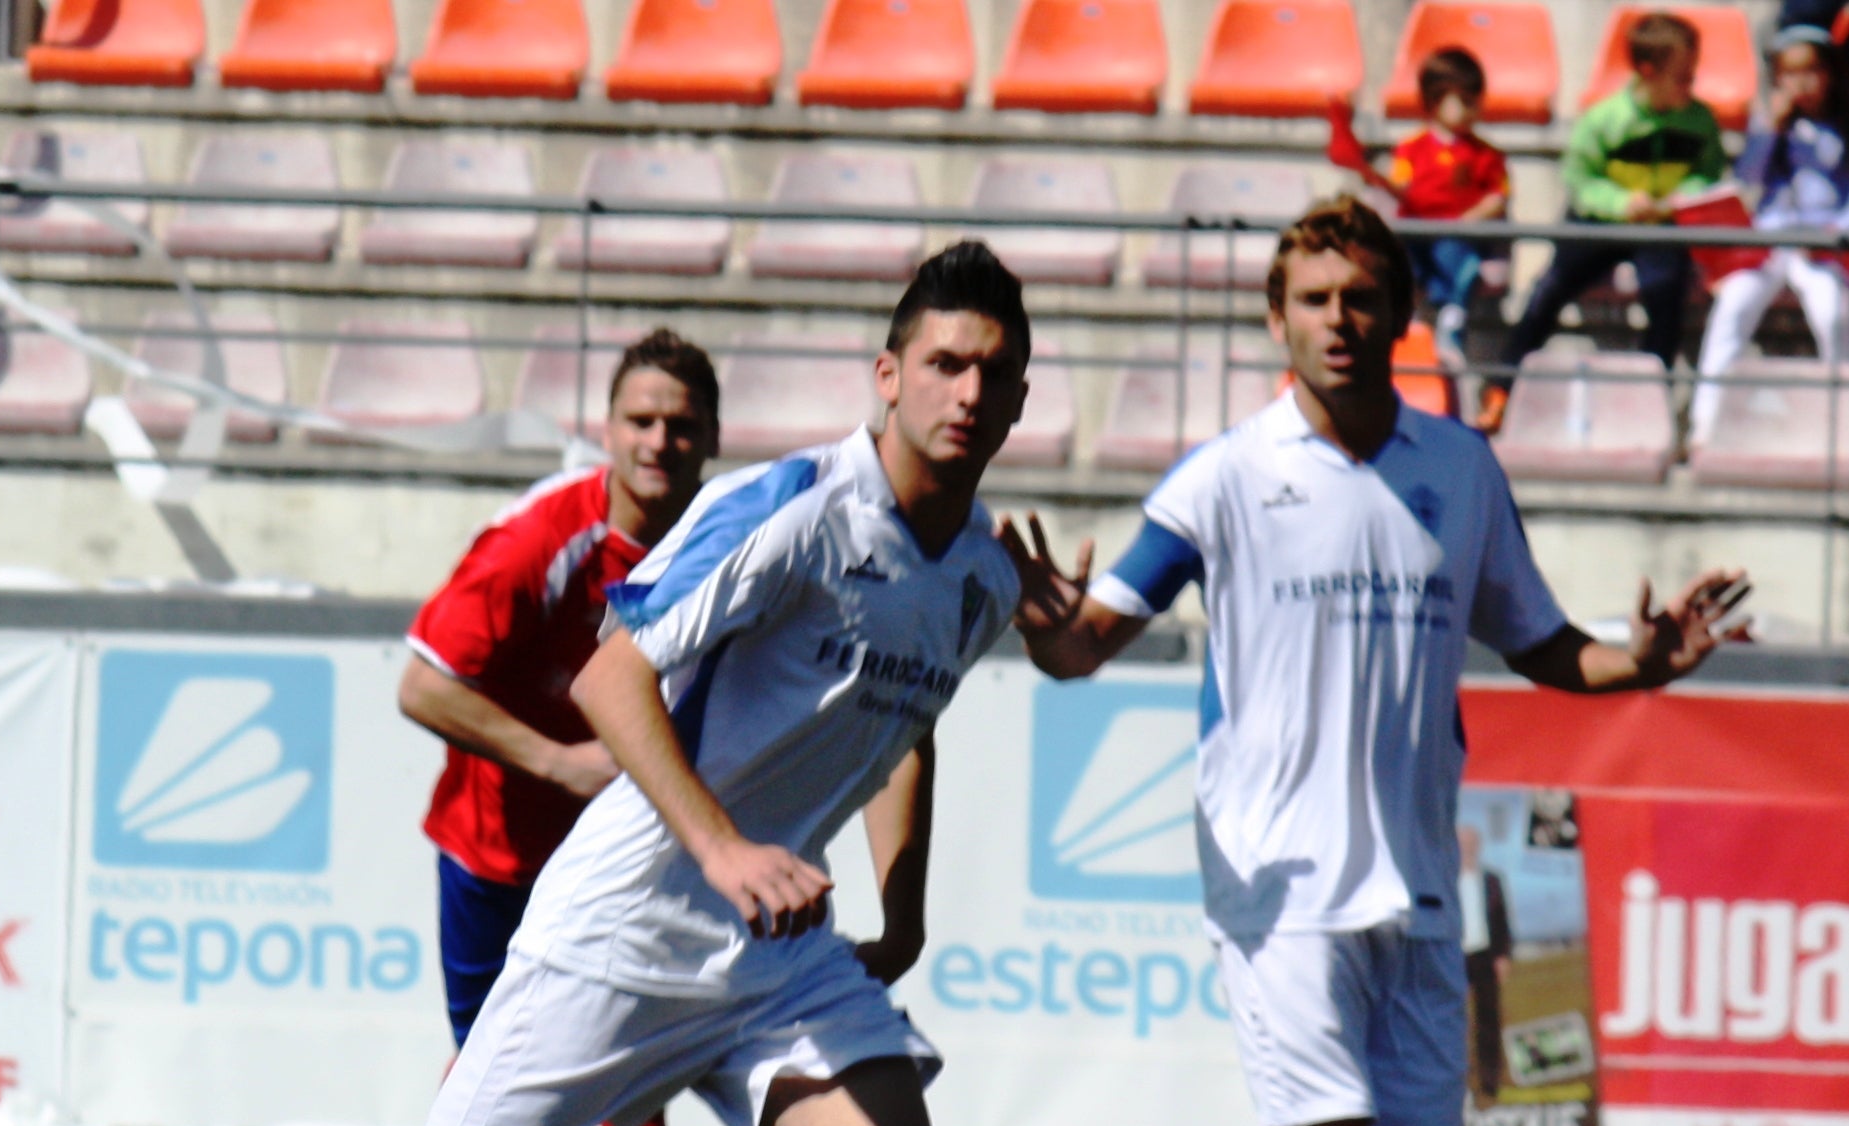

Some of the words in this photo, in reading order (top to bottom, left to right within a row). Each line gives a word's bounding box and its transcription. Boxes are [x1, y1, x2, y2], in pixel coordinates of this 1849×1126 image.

[88, 906, 423, 1005] tepona
[930, 941, 1231, 1040] estepo
[1599, 867, 1849, 1046] juga
